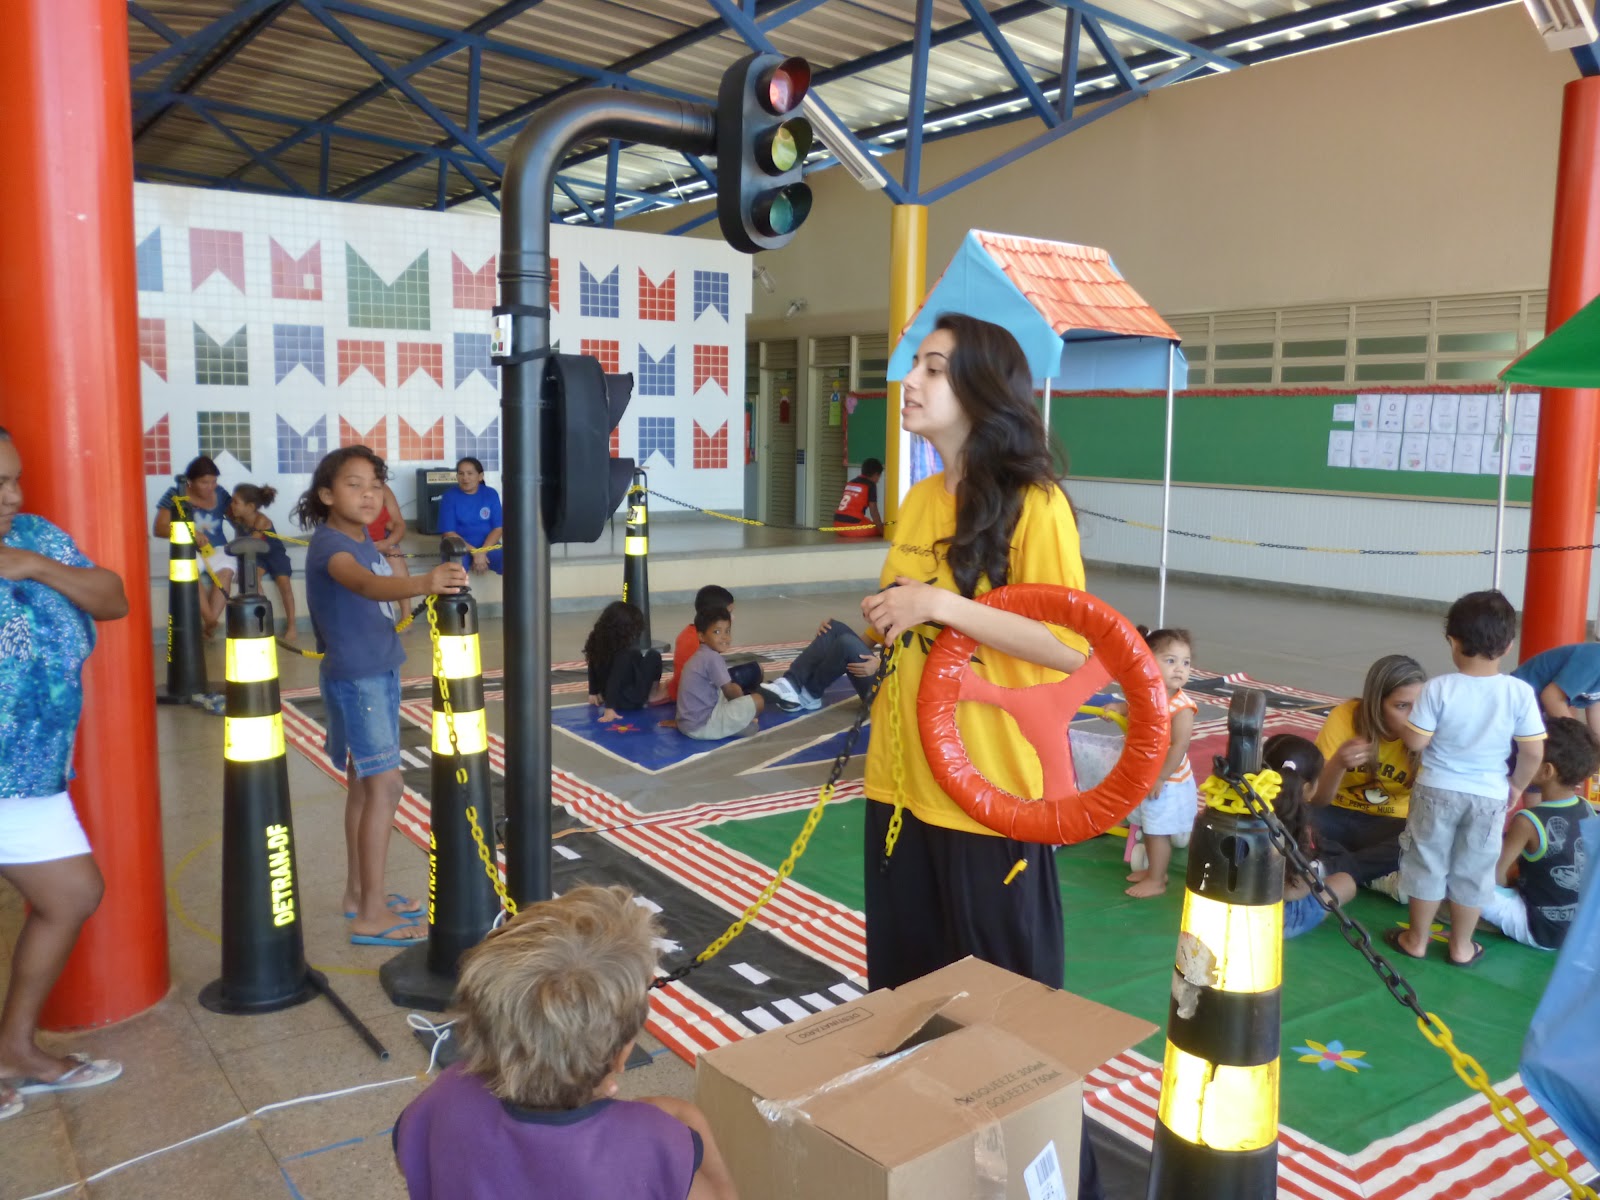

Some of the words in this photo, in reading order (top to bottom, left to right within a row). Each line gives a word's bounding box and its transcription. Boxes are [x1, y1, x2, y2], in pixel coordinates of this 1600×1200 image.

[1377, 805, 1396, 814] MUDE
[266, 824, 295, 926] DETRAN-DF
[971, 1072, 1018, 1099] SQUEEZE
[985, 1081, 1035, 1110] SQUEEZE
